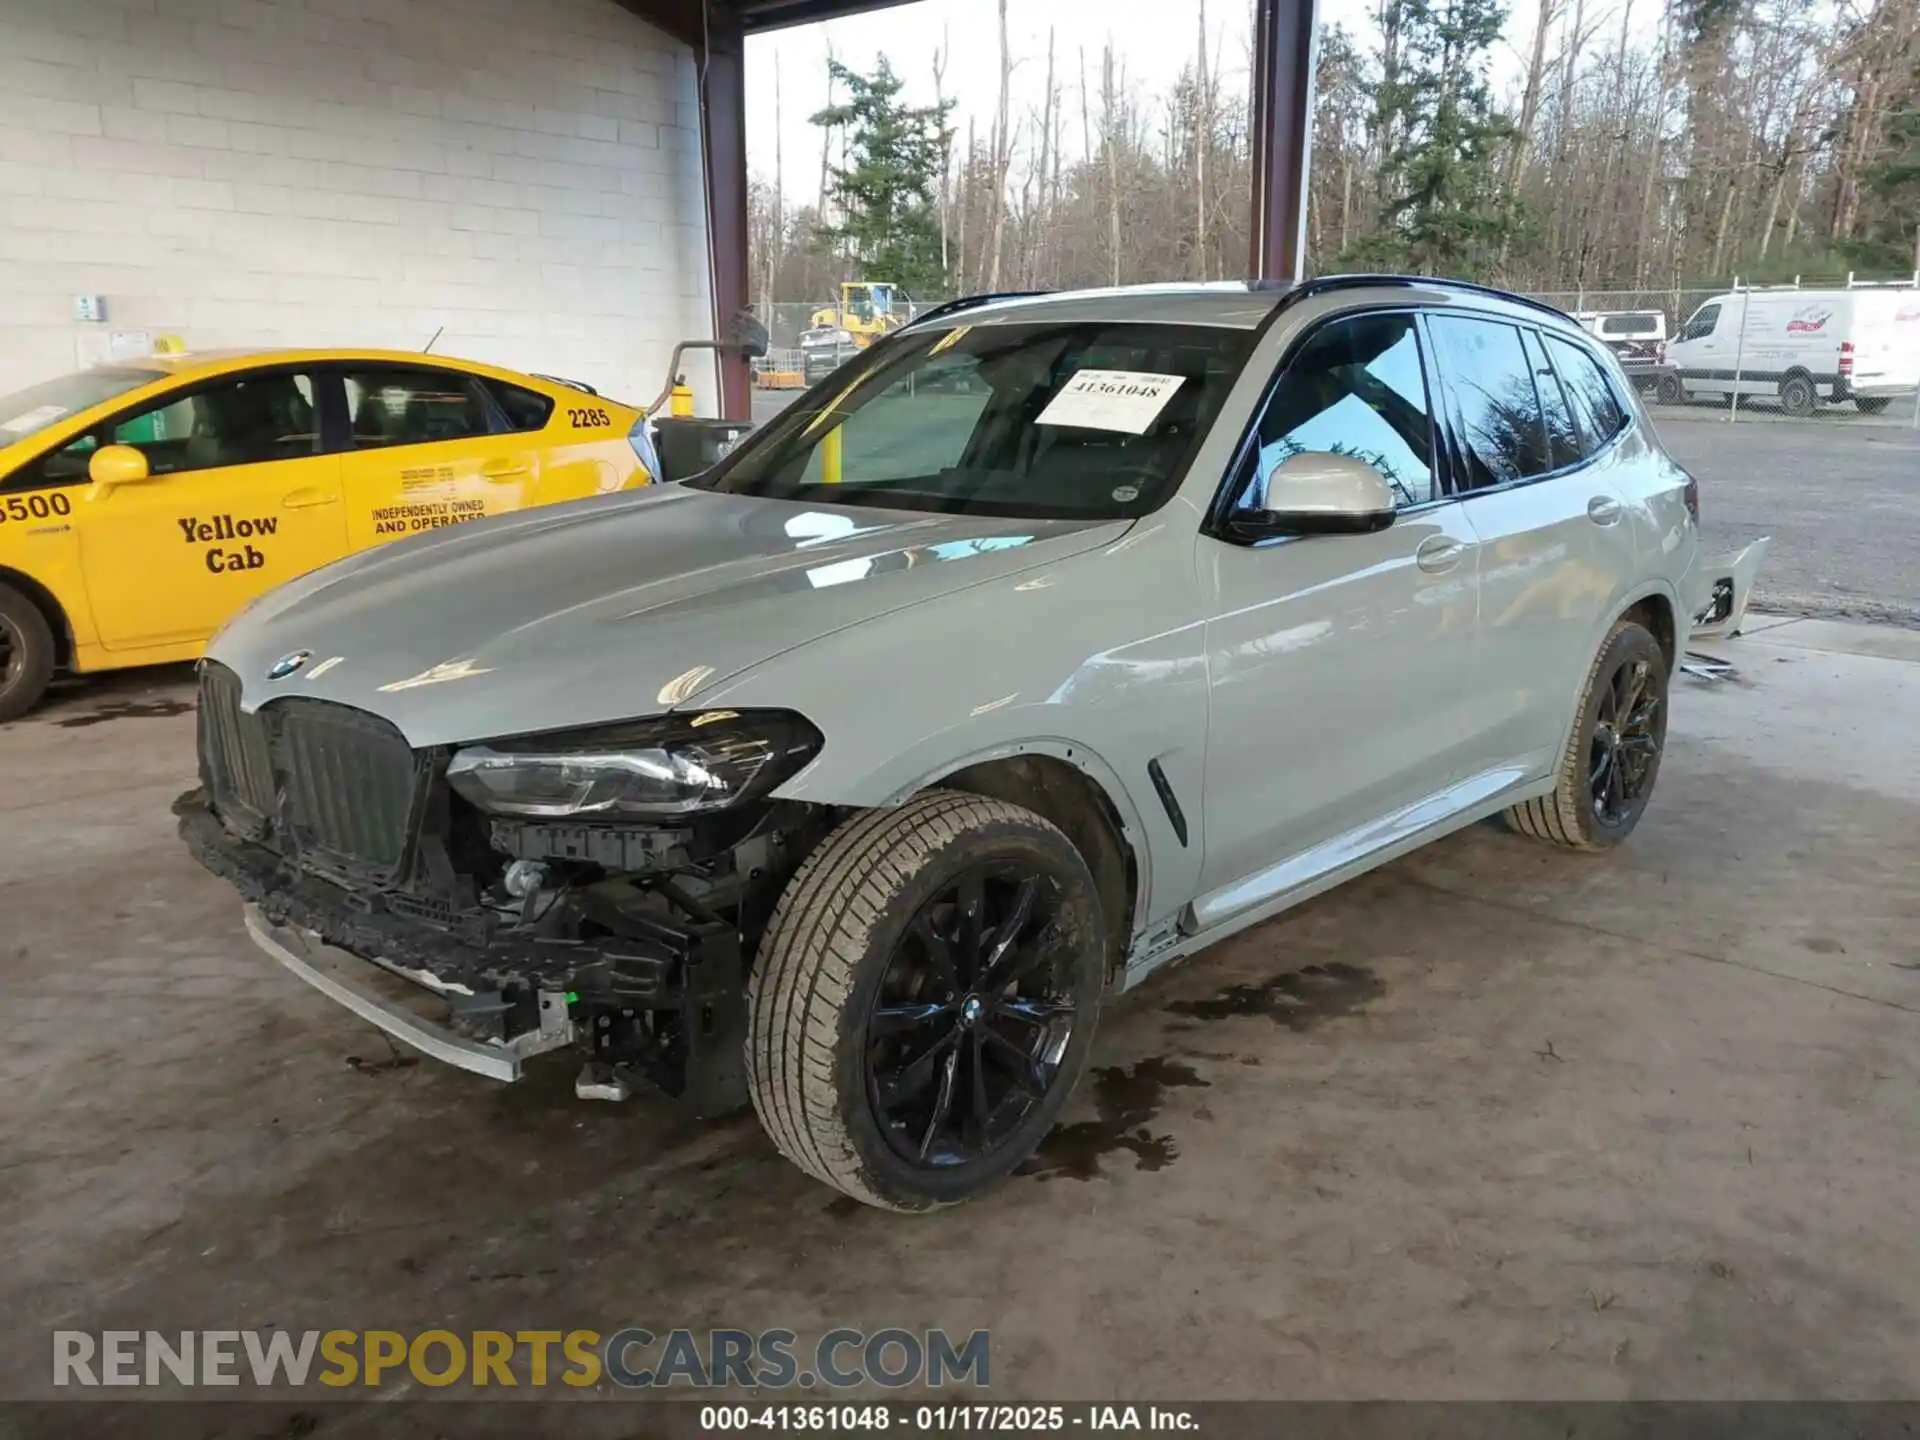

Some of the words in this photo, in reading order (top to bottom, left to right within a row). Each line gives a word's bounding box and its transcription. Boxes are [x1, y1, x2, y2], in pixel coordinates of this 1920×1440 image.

[1073, 382, 1161, 397] 41361048
[567, 408, 611, 429] 2285
[372, 502, 448, 520] INDEPENDENTLY
[451, 500, 485, 513] OWNED
[177, 514, 278, 543] Yellow
[376, 520, 406, 534] AND
[205, 544, 265, 574] Cab
